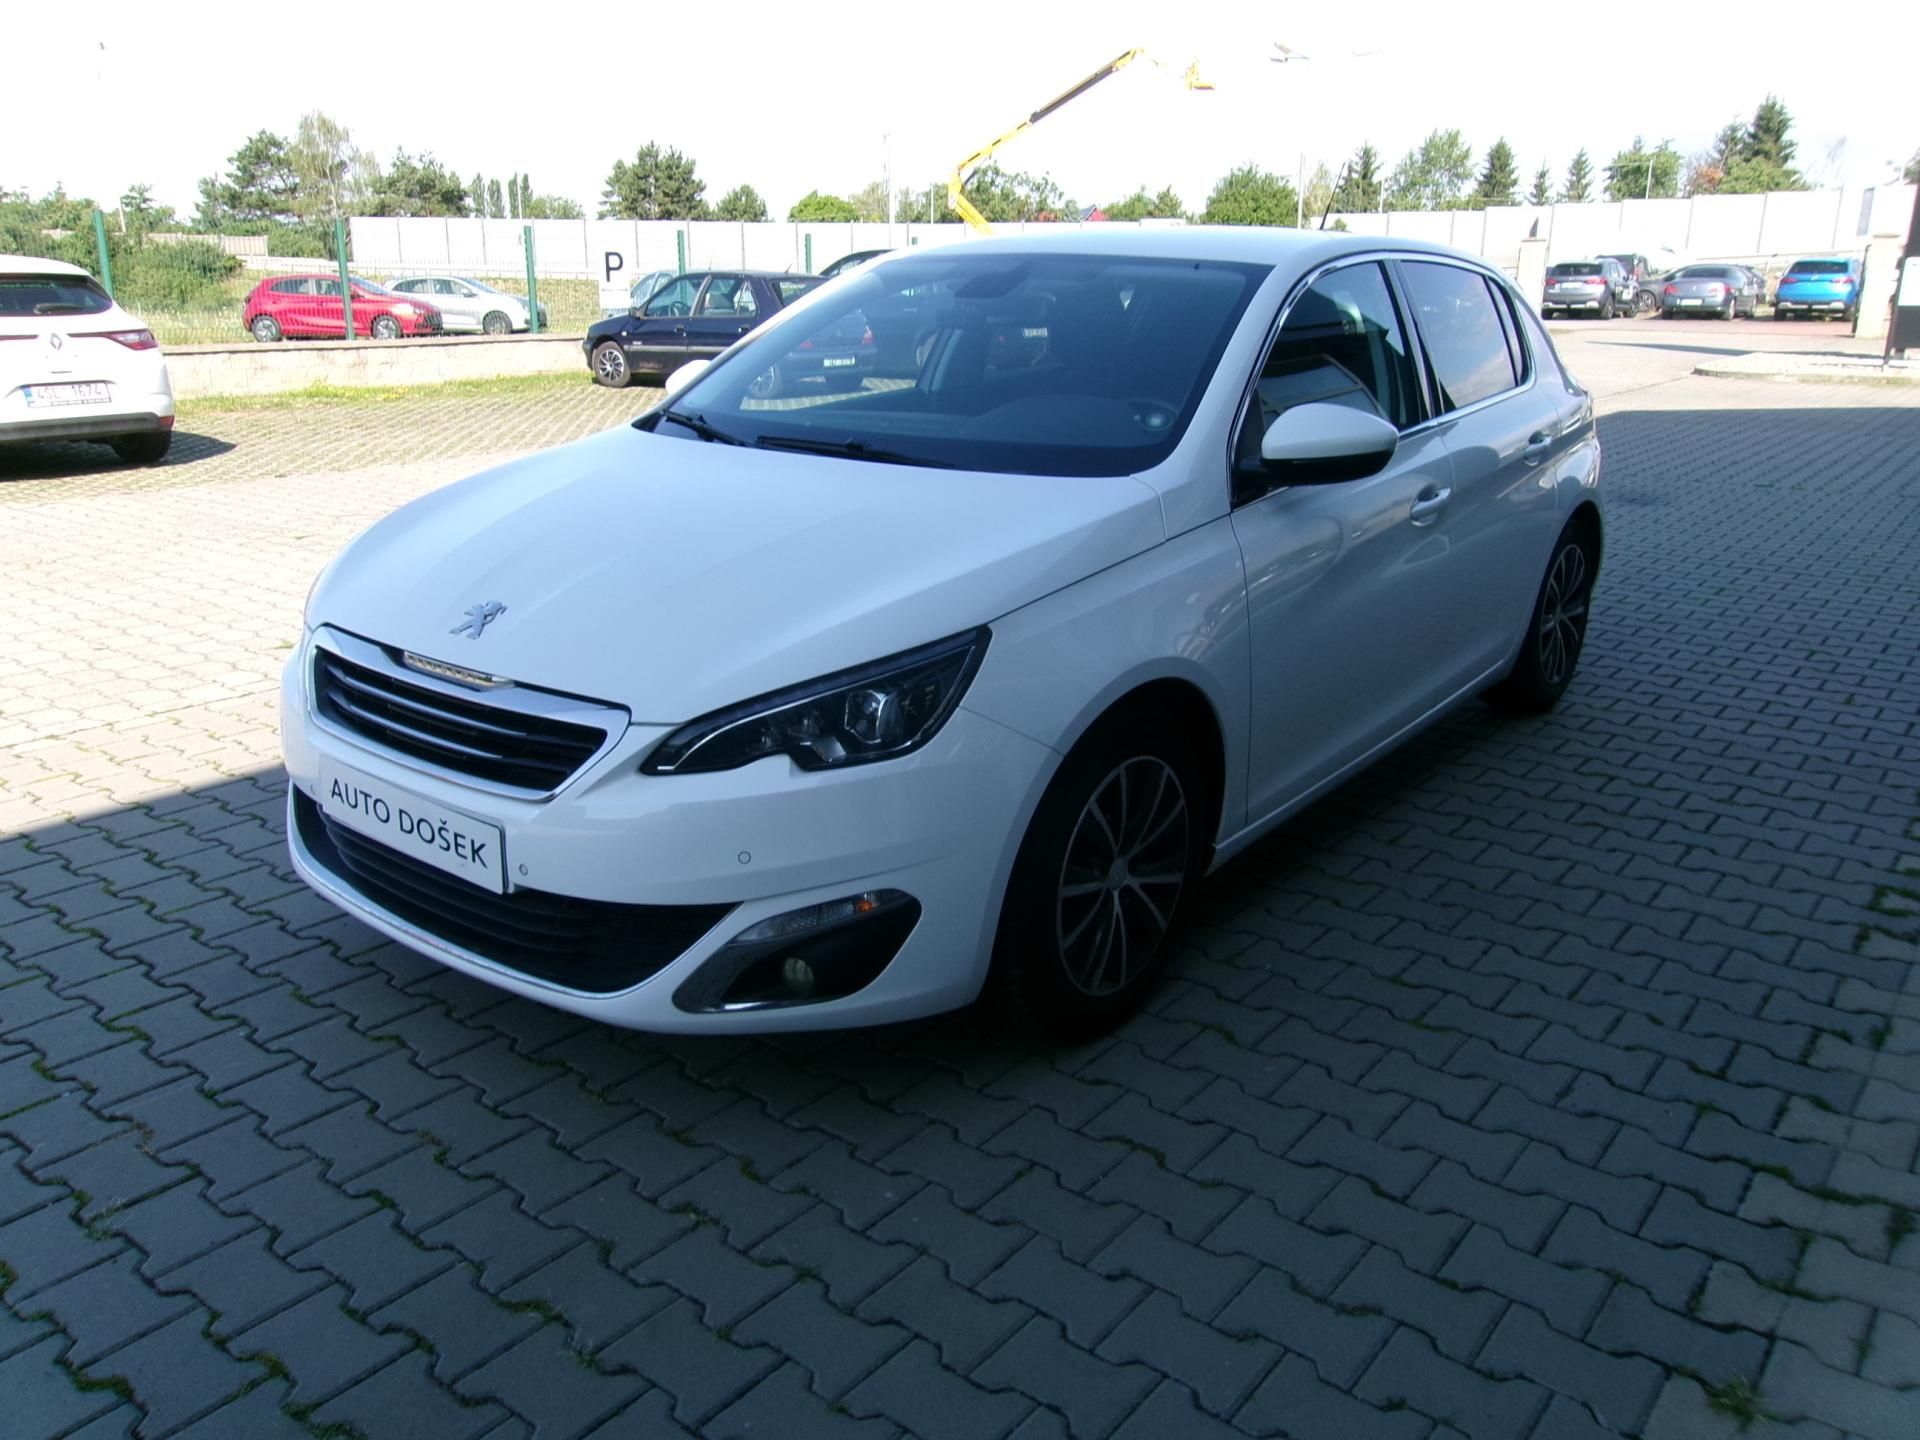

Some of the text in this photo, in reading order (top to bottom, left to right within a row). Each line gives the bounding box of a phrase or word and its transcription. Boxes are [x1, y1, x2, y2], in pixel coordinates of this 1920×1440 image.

[605, 252, 624, 282] P
[330, 778, 488, 869] AUTO DOŠEK
